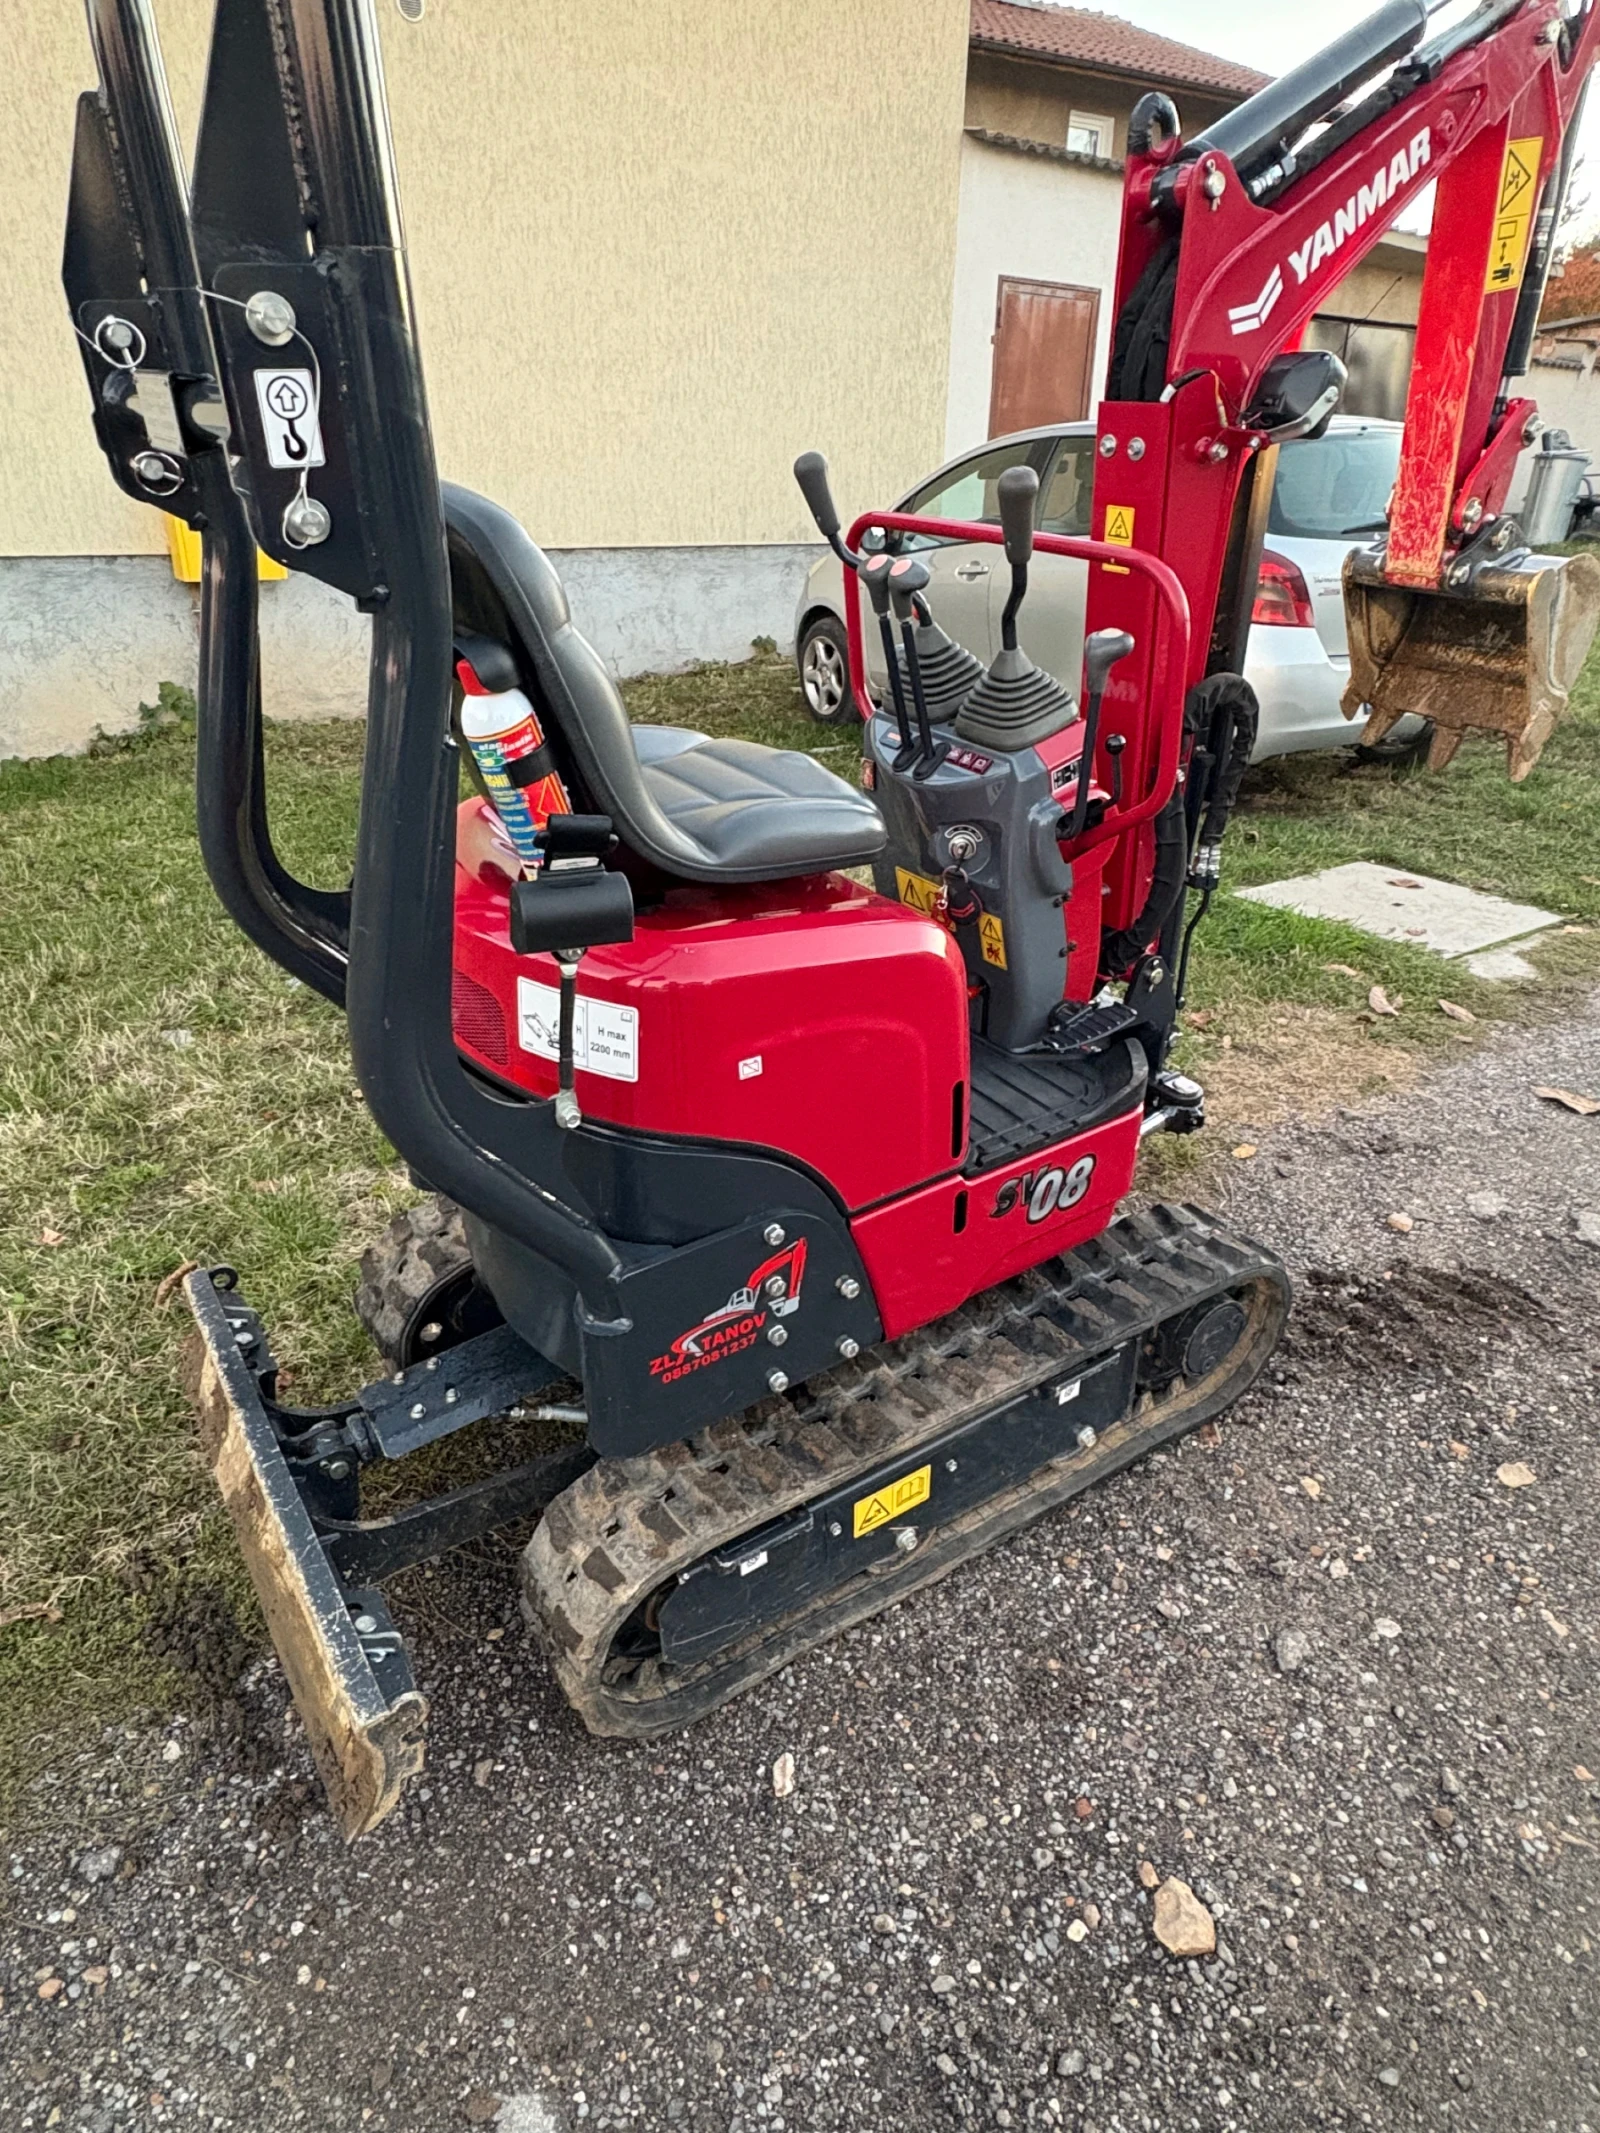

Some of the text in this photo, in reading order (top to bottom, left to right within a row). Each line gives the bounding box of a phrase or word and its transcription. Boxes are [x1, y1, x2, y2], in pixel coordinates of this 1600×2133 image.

[1287, 126, 1431, 285] YANMAR
[590, 1042, 611, 1055] 2200
[613, 1050, 631, 1059] mm
[598, 1026, 626, 1041] H max
[662, 1333, 757, 1384] 0887081237
